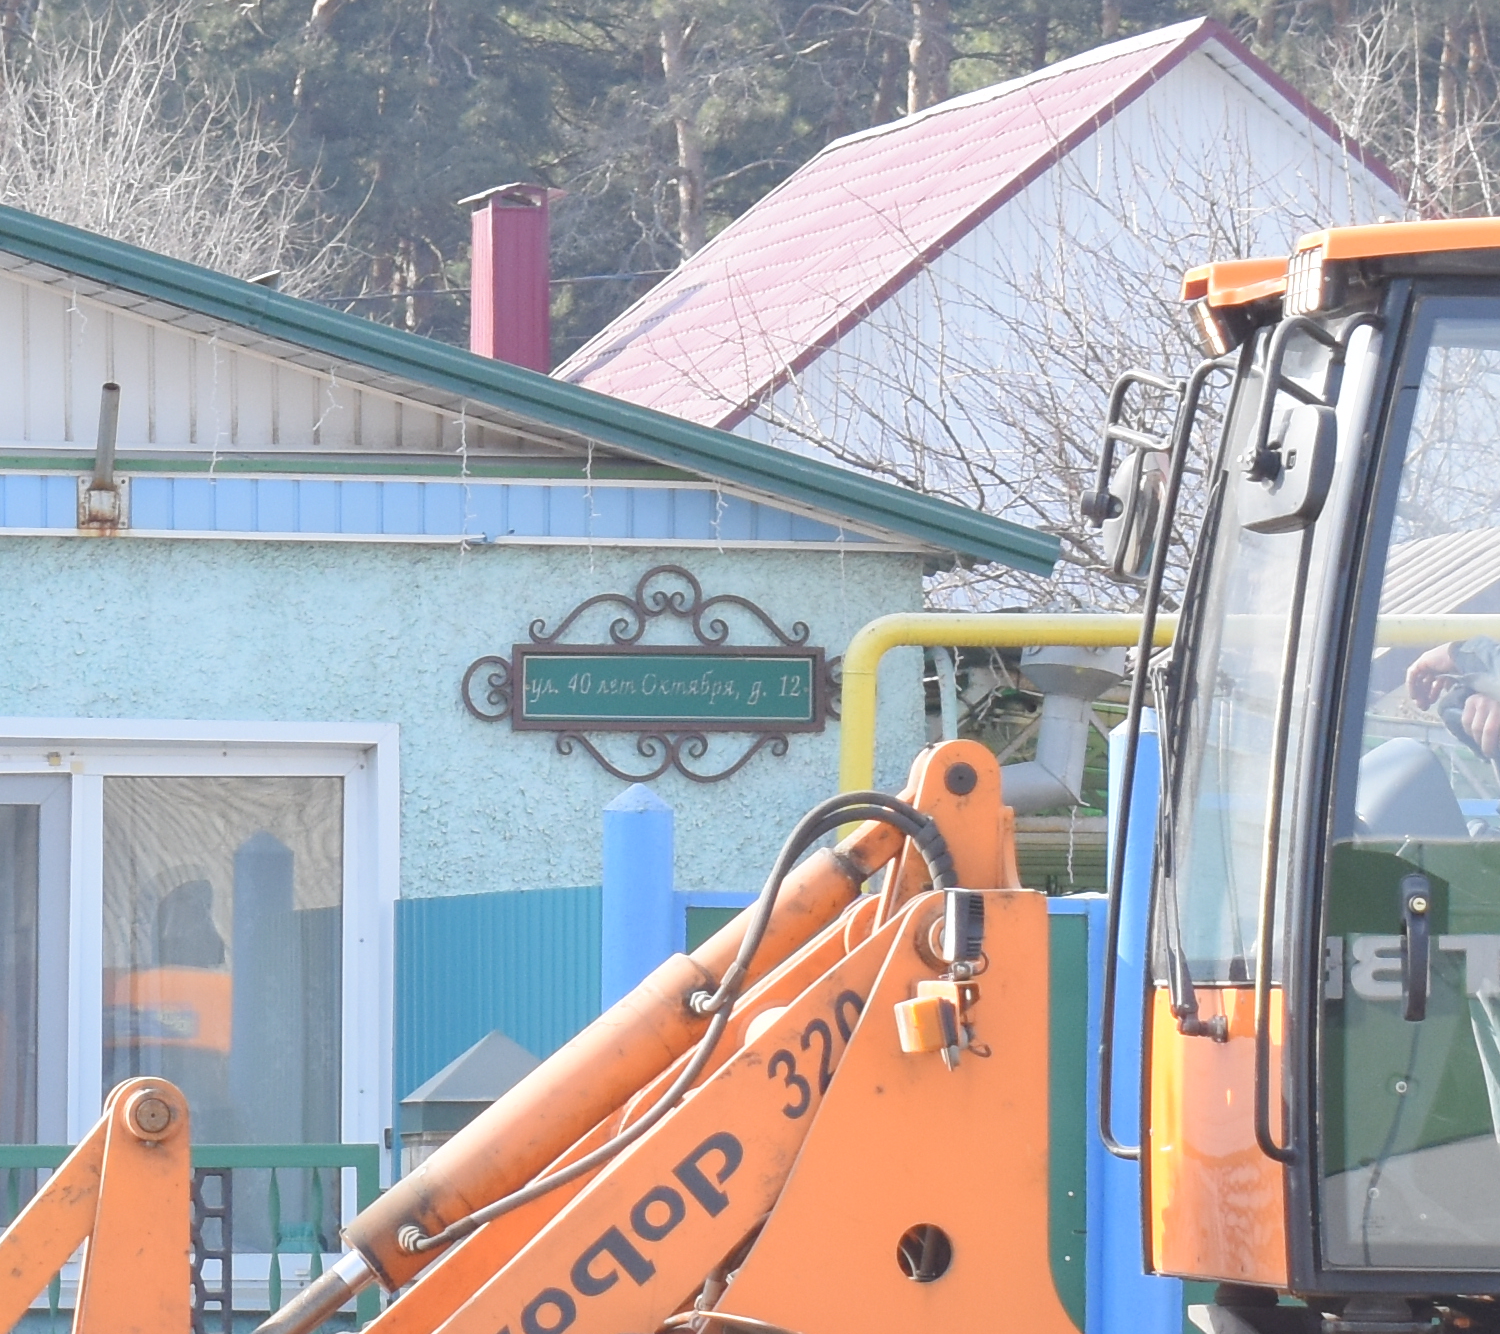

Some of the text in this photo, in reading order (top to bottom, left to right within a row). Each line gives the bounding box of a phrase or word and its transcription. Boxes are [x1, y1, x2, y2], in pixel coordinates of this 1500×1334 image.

[529, 669, 802, 705] ул. 40 лет Октября, д. 12
[767, 988, 865, 1121] 320
